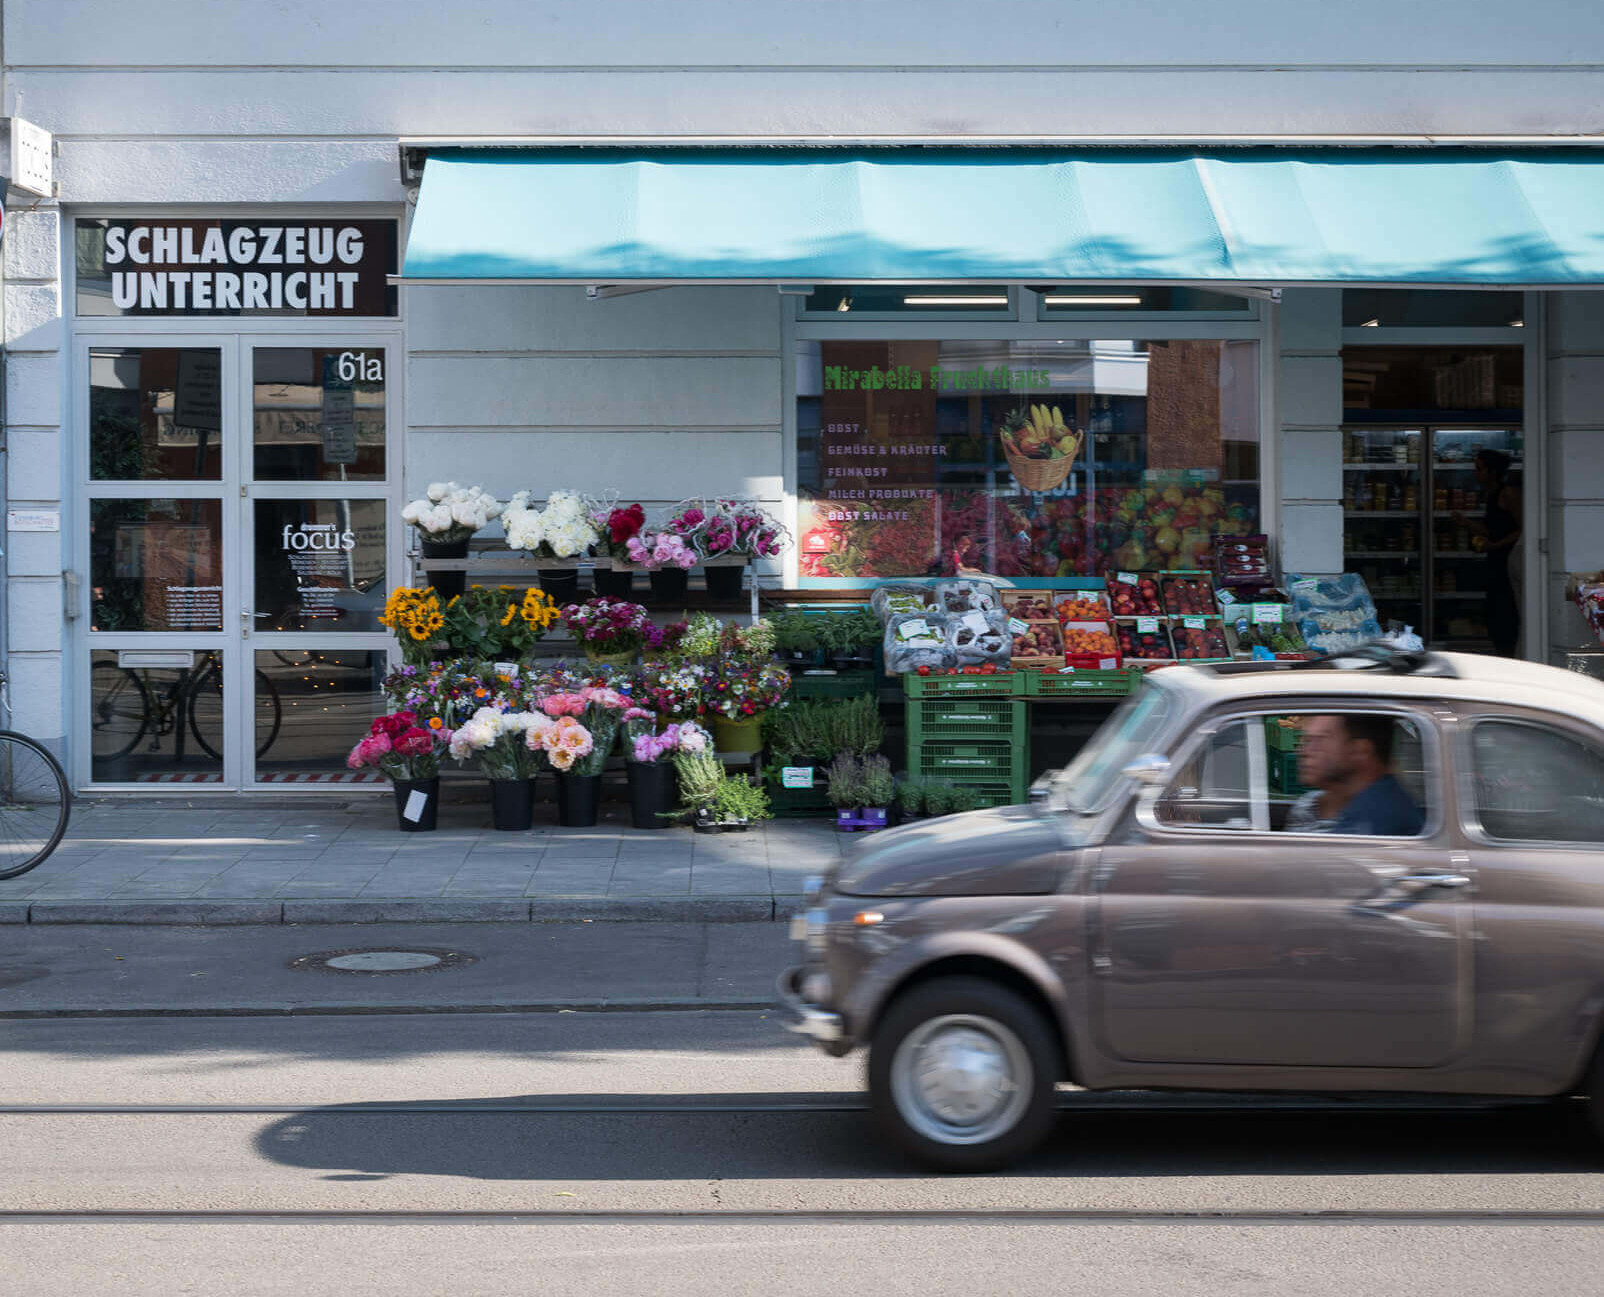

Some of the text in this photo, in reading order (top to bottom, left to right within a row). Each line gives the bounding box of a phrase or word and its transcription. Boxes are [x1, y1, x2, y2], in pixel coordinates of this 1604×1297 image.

[105, 226, 365, 265] SCHLAGZEUG
[111, 271, 359, 310] UNTERRICHT
[338, 351, 383, 382] 61a
[824, 365, 1050, 390] Mirabella Fruchthaus
[828, 423, 859, 433] OBST
[828, 444, 947, 456] GEMÜSE & KRÄUTER
[828, 467, 888, 477] FEINKOST
[828, 489, 934, 499] MILCH PRODUKTE
[828, 511, 908, 521] OBST SALATE
[281, 524, 356, 550] focus
